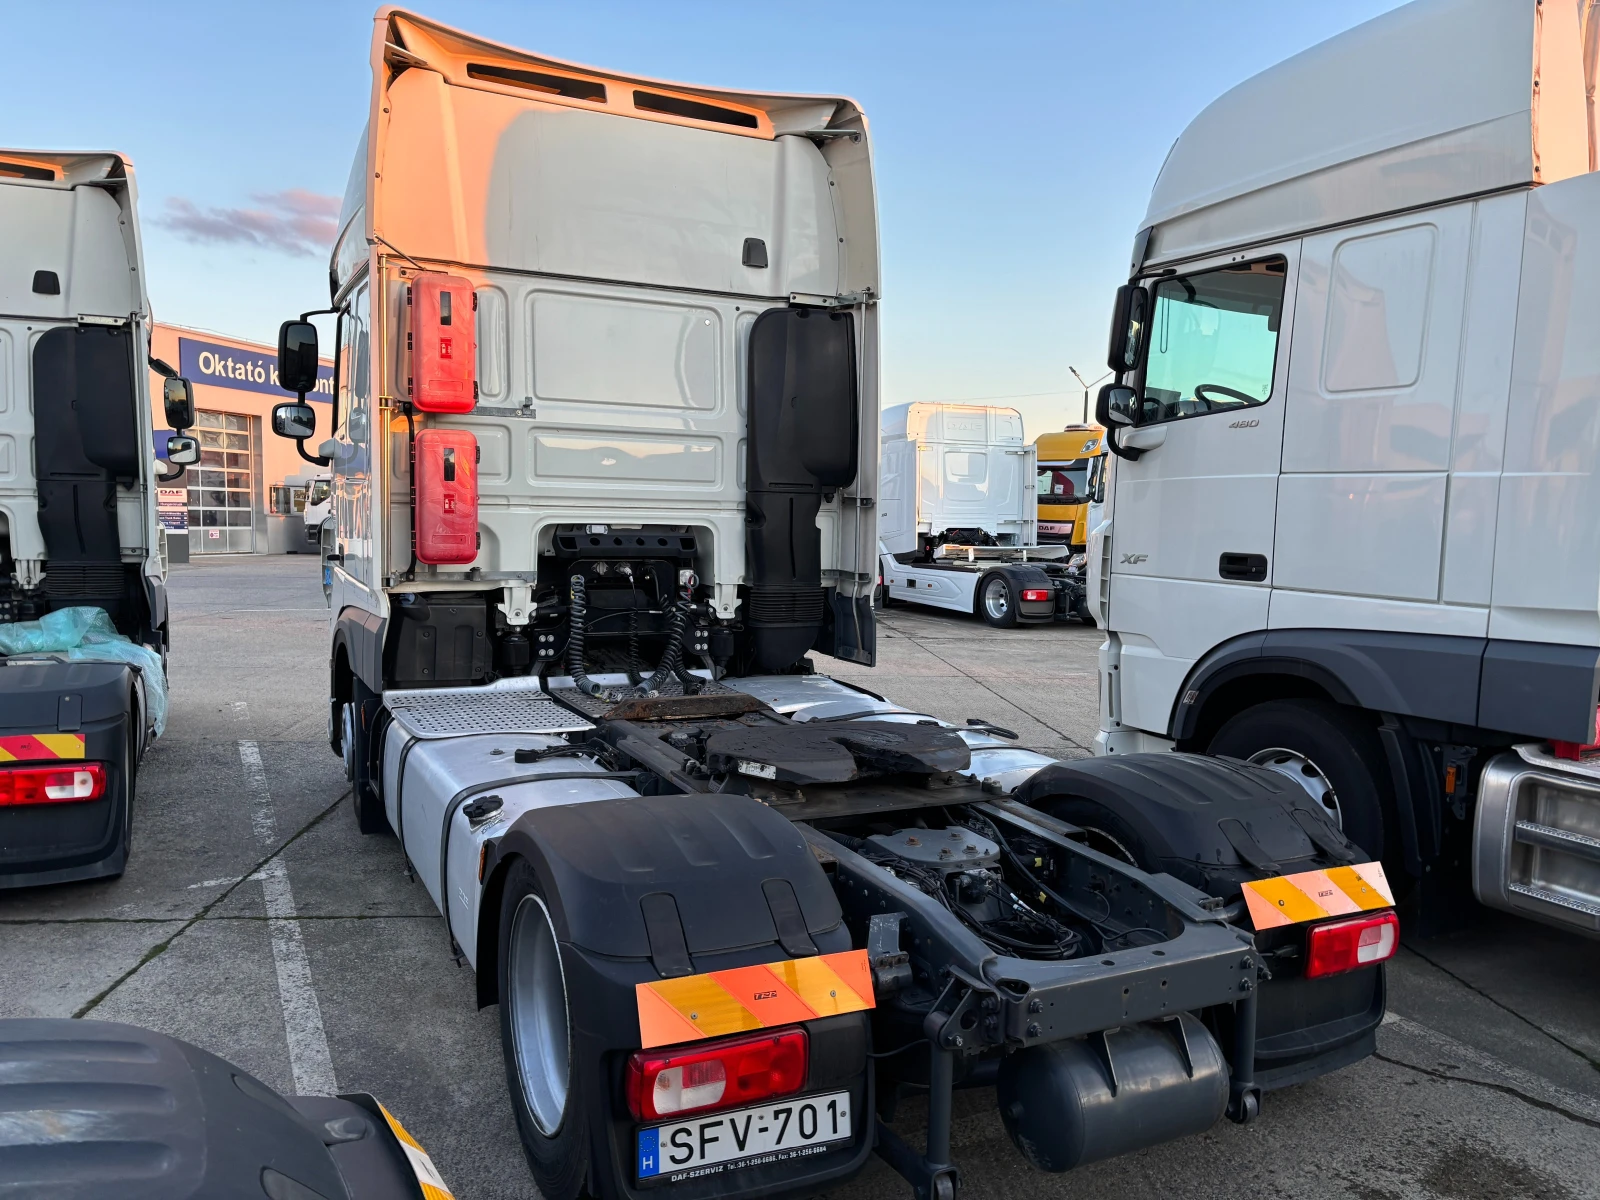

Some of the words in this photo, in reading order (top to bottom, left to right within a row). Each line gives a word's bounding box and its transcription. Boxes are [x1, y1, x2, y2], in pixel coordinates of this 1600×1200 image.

[199, 351, 266, 384] Oktató
[1228, 419, 1260, 429] 480
[1120, 553, 1149, 565] XF
[669, 1099, 838, 1165] SFV-701
[642, 1155, 654, 1170] H
[671, 1165, 724, 1182] DAF-SZERVIZ
[778, 1151, 789, 1161] Fax:
